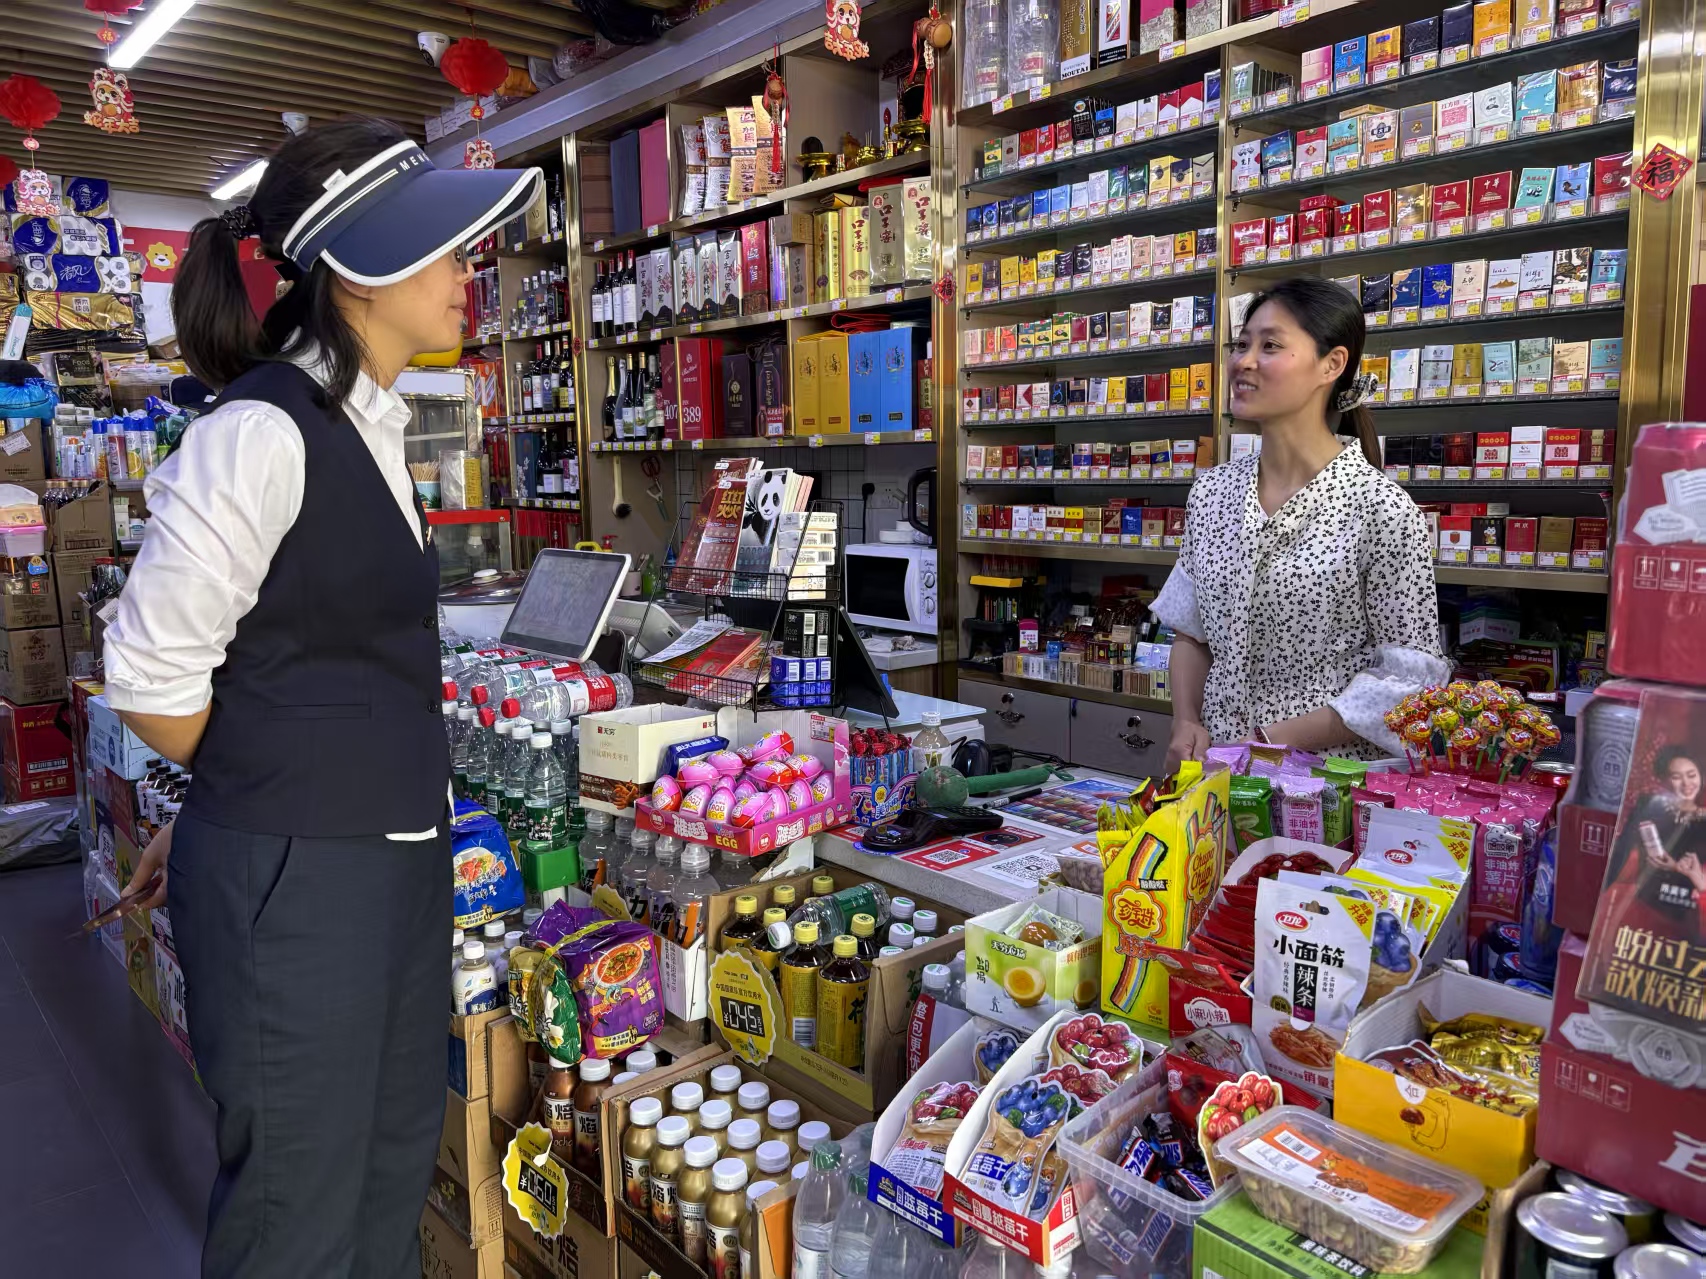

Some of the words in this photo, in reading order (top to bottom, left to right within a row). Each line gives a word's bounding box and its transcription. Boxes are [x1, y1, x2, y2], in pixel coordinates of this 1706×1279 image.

[1062, 67, 1089, 79] MOUTAI
[84, 111, 139, 134] 蛇年大吉
[1645, 157, 1675, 187] 福
[1444, 186, 1457, 197] 中华
[1484, 177, 1500, 189] 中华
[879, 204, 893, 244] 口子窖
[915, 196, 931, 237] 口子窖
[852, 219, 865, 253] 口子窖
[60, 265, 92, 281] 清风
[941, 281, 953, 296] 福
[664, 405, 678, 420] 407
[683, 406, 701, 423] 389
[1289, 818, 1318, 829] 非油炸
[715, 836, 738, 850] EGG
[1484, 858, 1520, 872] 非油炸
[1484, 871, 1520, 887] 薯片
[1279, 914, 1304, 929] 卫龙
[1273, 934, 1346, 969] 小面筋
[1294, 966, 1316, 1007] 辣条
[1303, 1070, 1334, 1091] 销量
[552, 1136, 573, 1148] ocha
[969, 1154, 1008, 1179] 蓝莓干
[904, 1191, 944, 1226] 蓝莓干
[981, 1202, 1029, 1241] 蔓越莓干
[1299, 1239, 1367, 1277] 果味茶饮料
